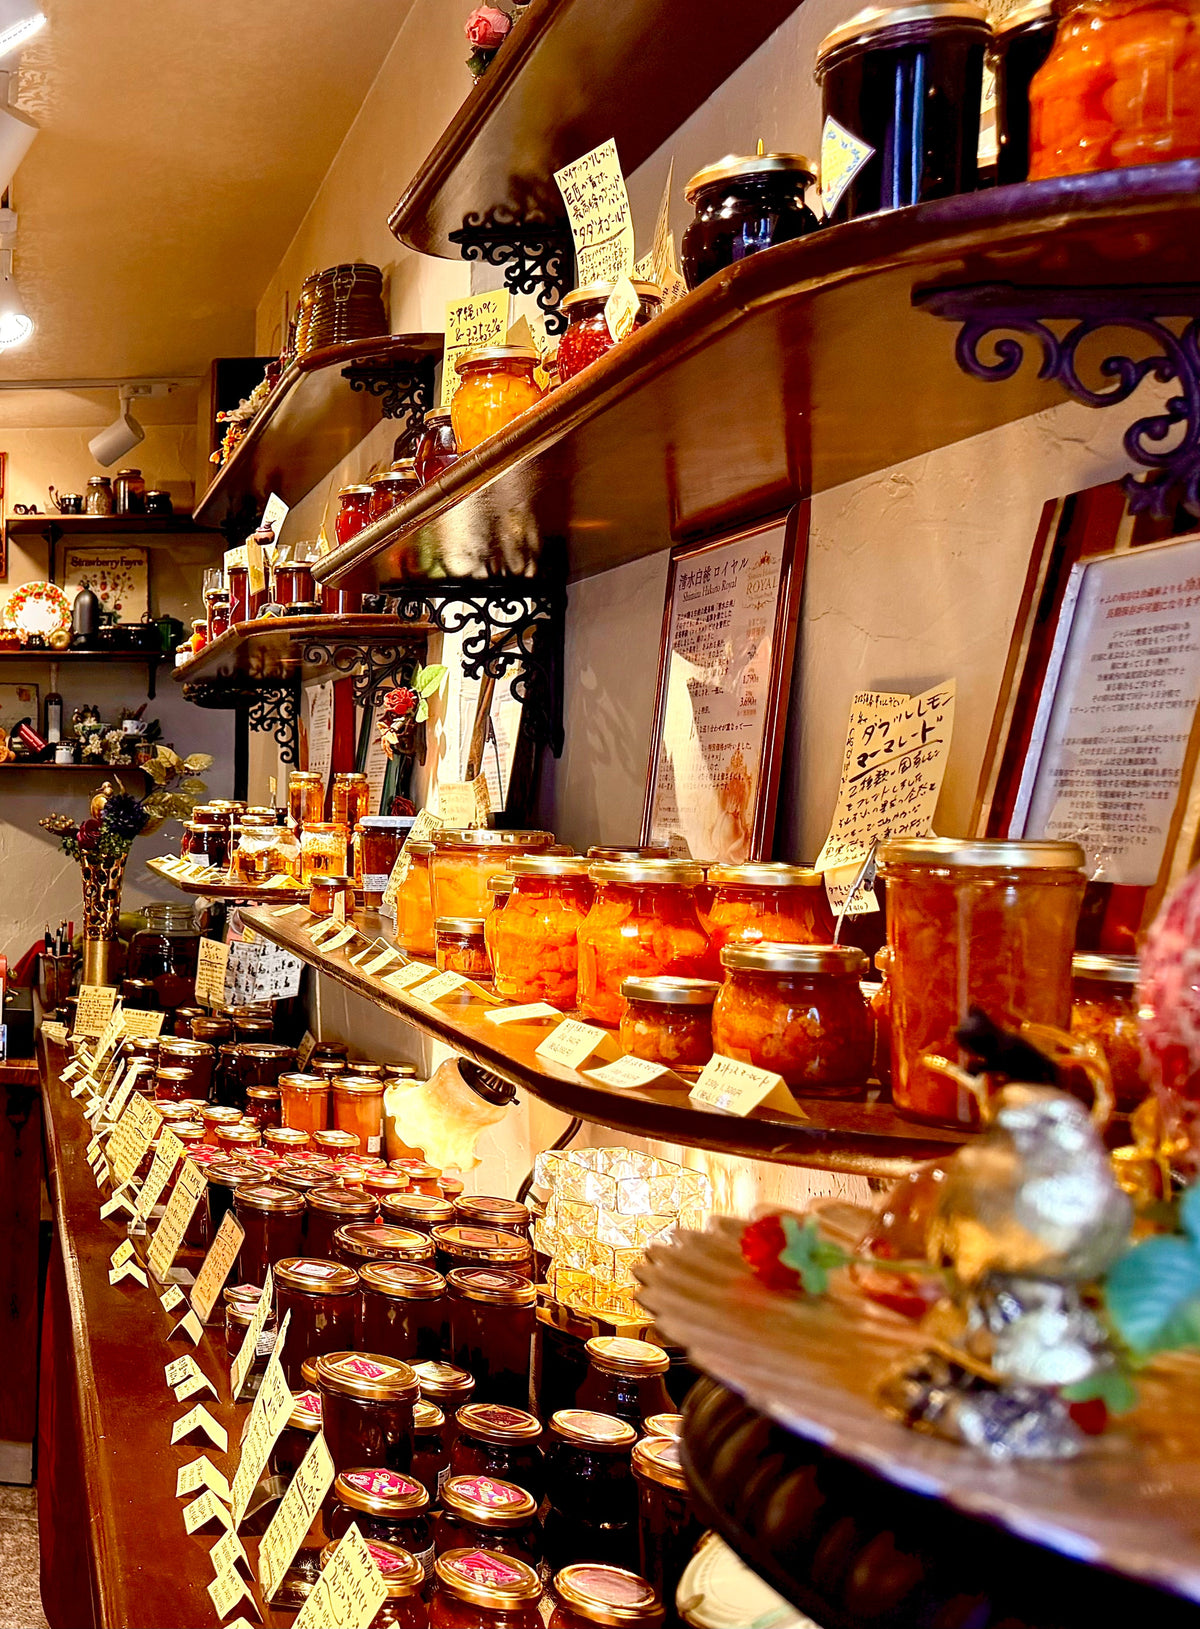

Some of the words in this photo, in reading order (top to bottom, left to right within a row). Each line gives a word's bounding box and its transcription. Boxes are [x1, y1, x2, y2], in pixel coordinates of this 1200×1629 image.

[71, 556, 119, 569] Strawberry
[120, 556, 144, 570] Fayre
[714, 557, 749, 578] ロイヤル
[746, 576, 778, 595] ROYAL
[862, 691, 954, 746] ダブルレモン
[857, 715, 945, 768] マーマレード
